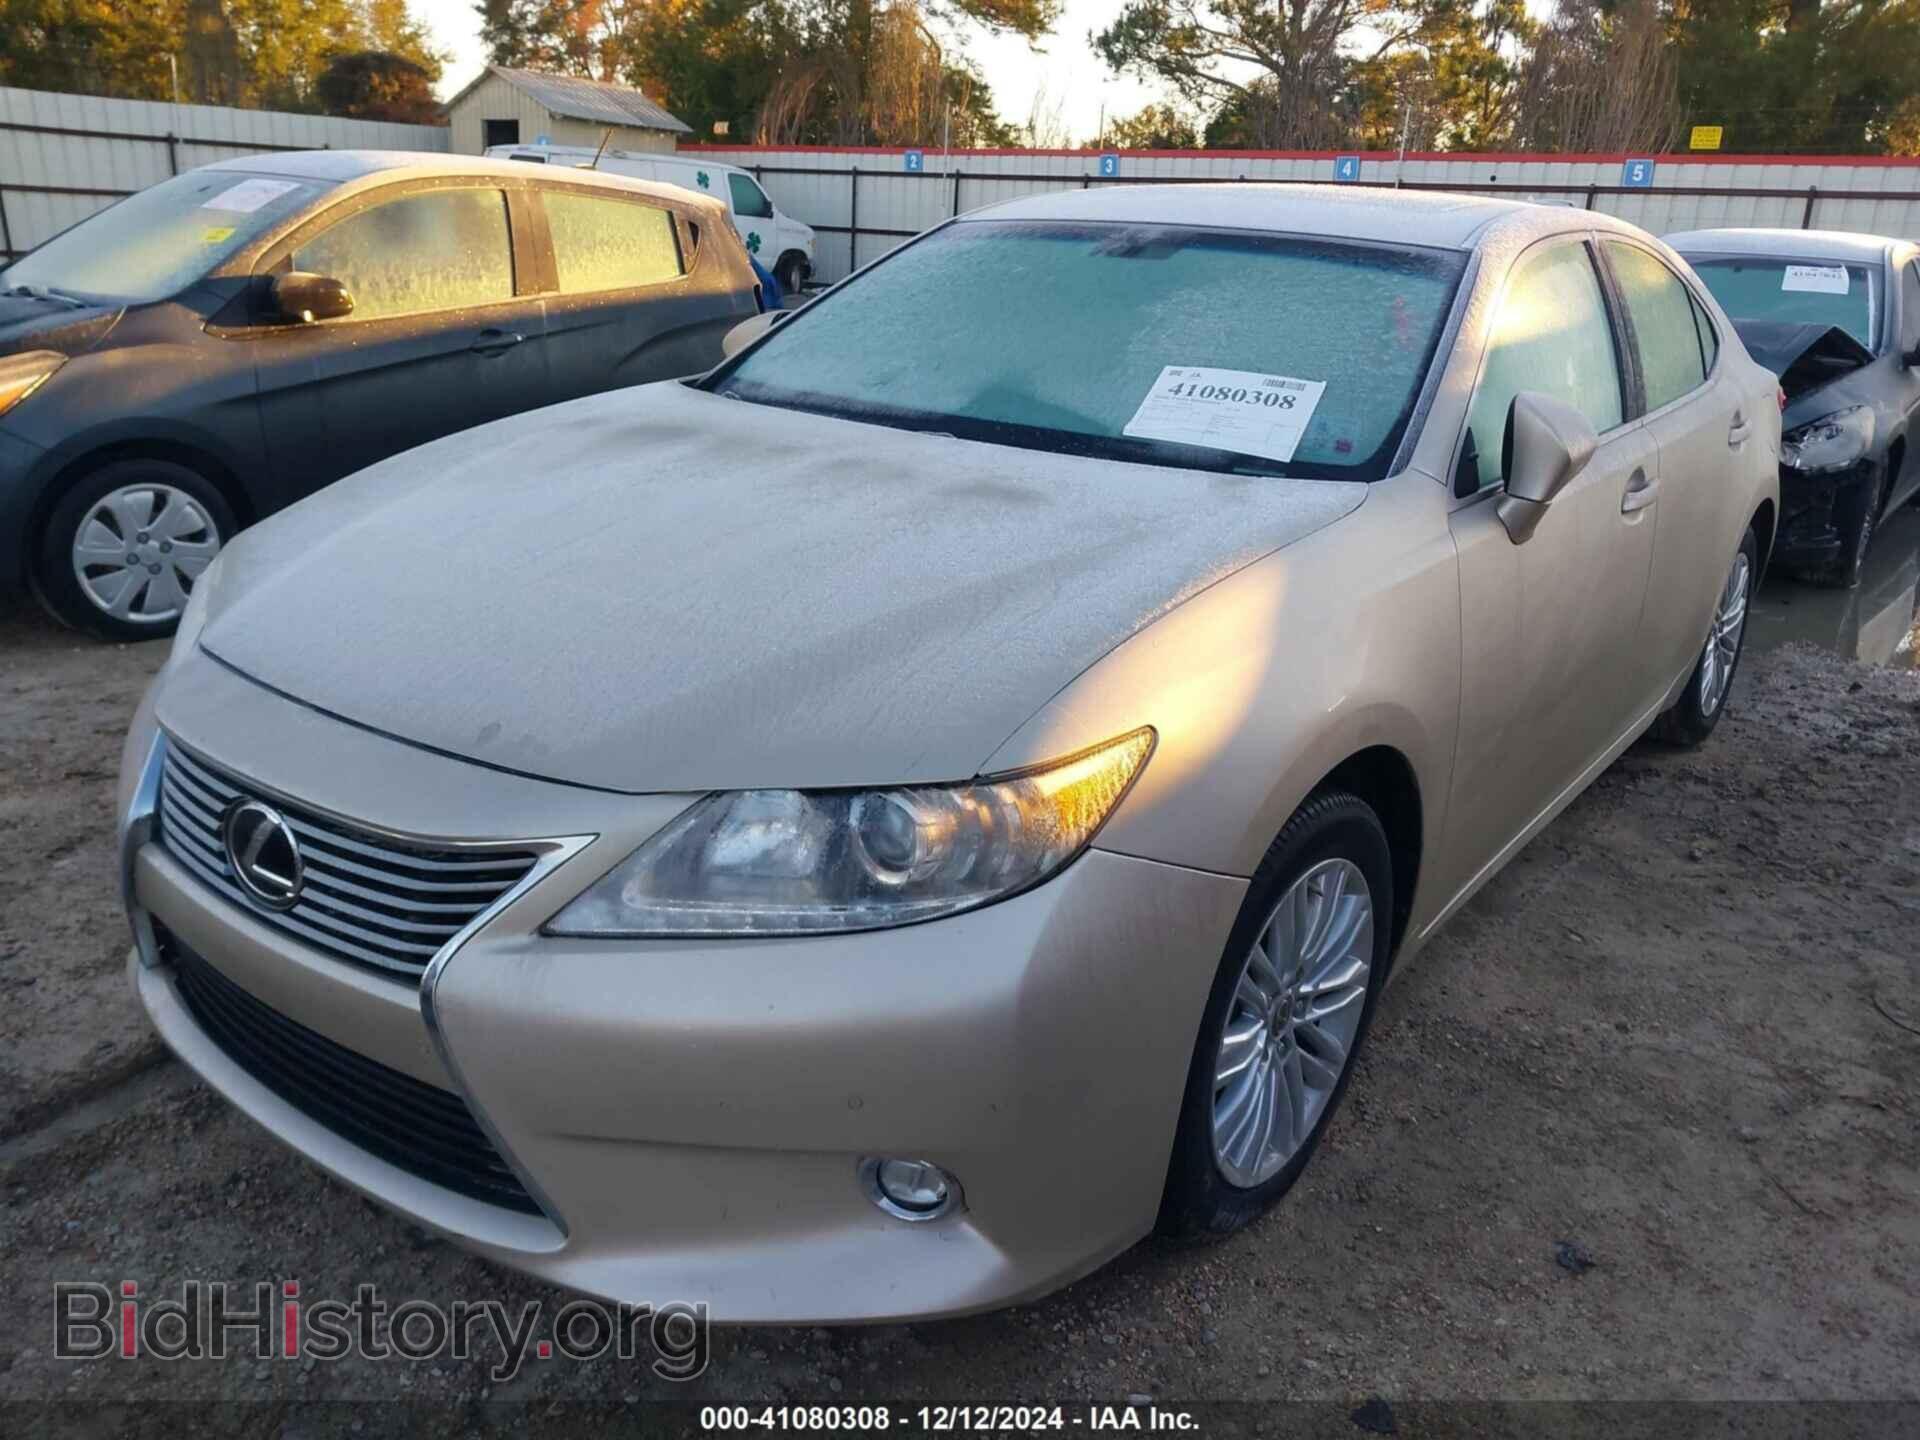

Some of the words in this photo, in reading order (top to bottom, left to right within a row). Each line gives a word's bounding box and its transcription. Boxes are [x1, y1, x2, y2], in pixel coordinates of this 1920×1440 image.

[910, 154, 918, 169] 2
[1105, 158, 1113, 174] 3
[1342, 161, 1352, 176] 4
[1632, 164, 1644, 181] 5
[1168, 383, 1297, 409] 41080308
